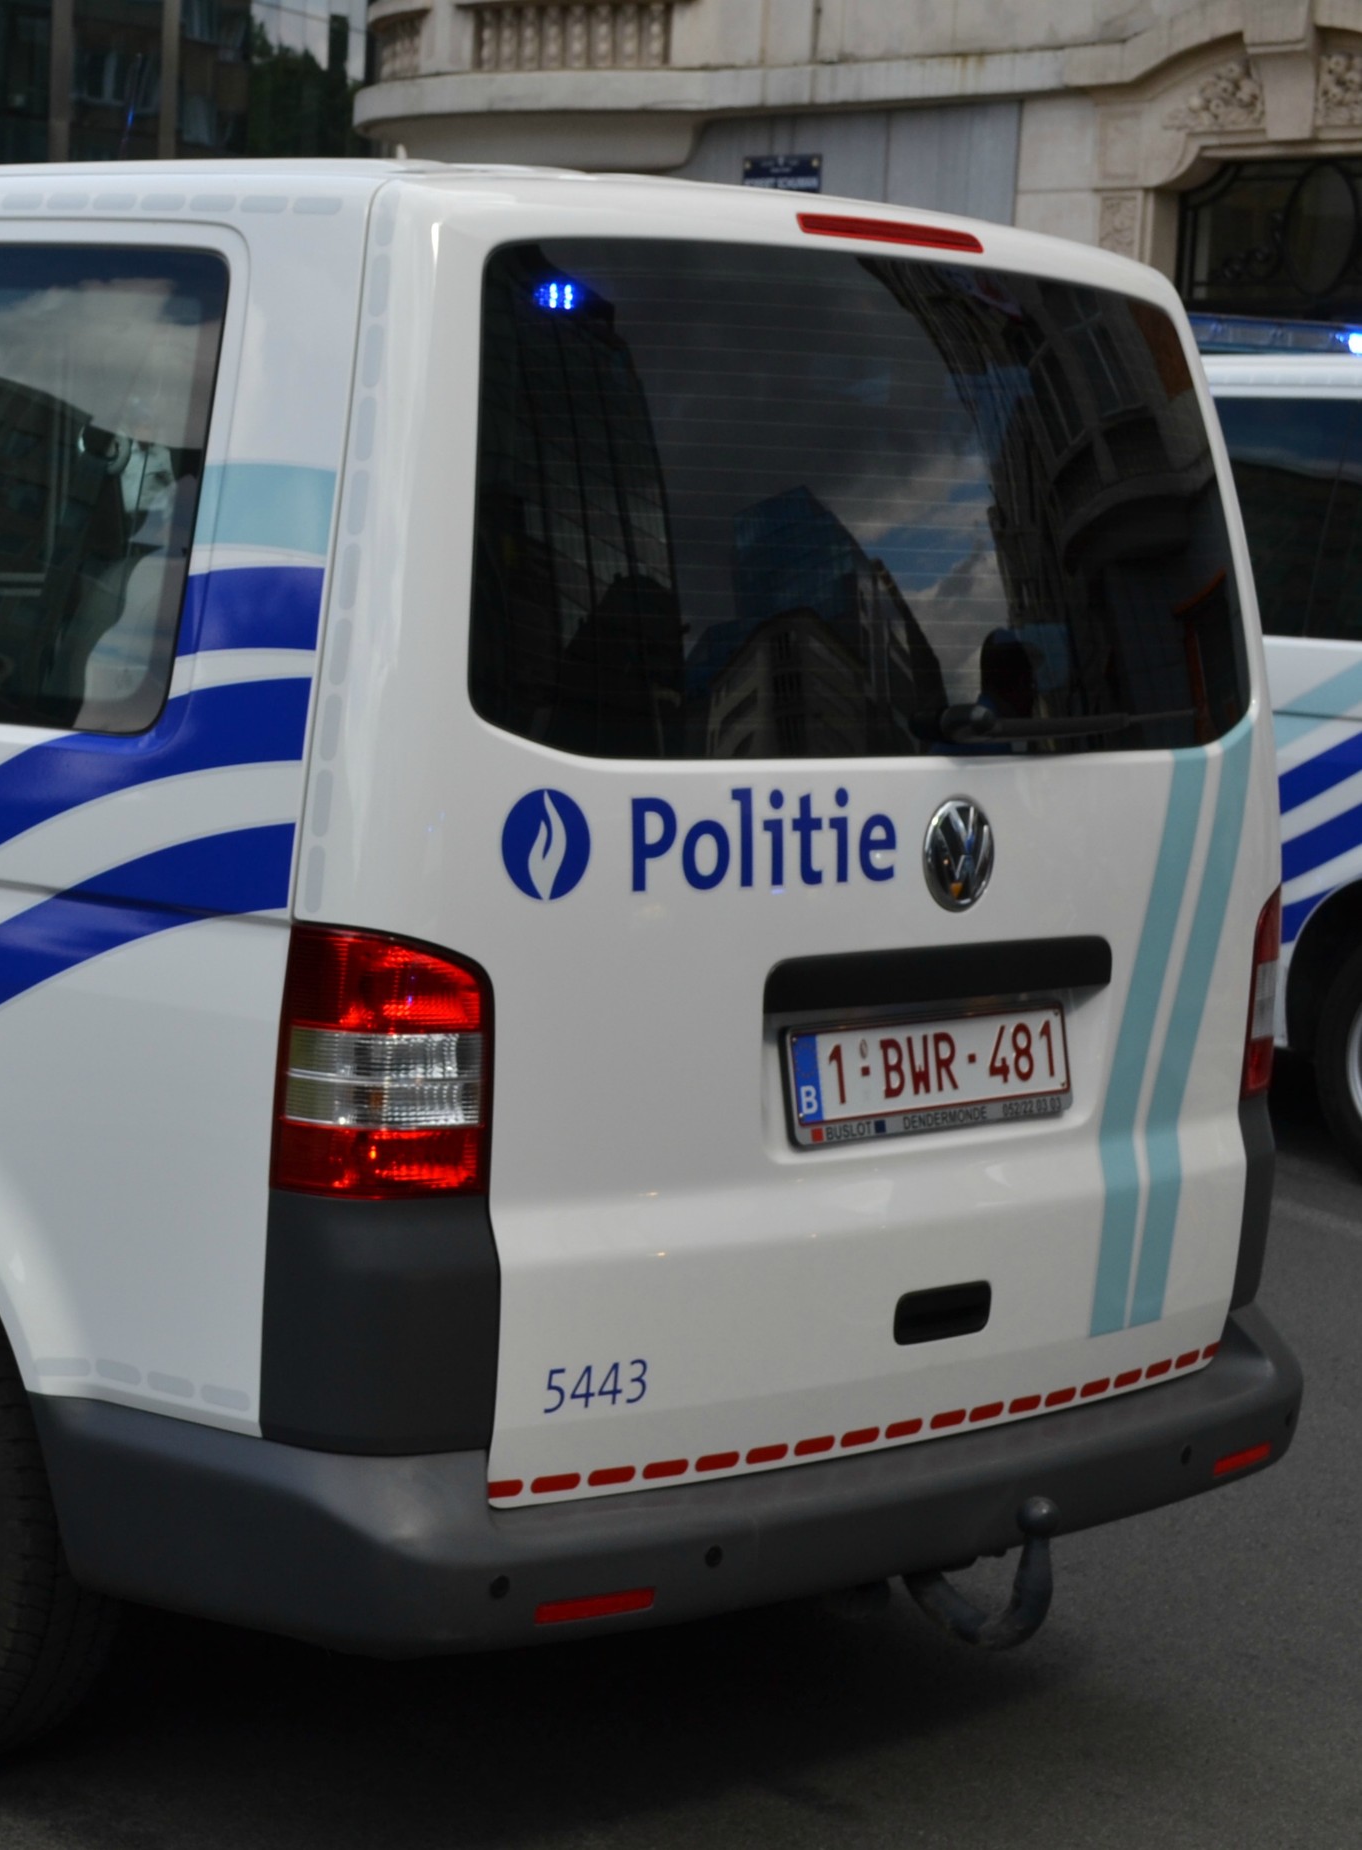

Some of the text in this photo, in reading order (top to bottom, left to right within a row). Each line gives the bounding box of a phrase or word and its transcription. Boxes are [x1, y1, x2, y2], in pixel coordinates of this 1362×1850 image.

[631, 787, 897, 892] Politie
[800, 1085, 819, 1115] B
[825, 1120, 873, 1141] BUSLOT
[902, 1105, 988, 1130] DENDERMONDE
[543, 1358, 648, 1414] 5443
